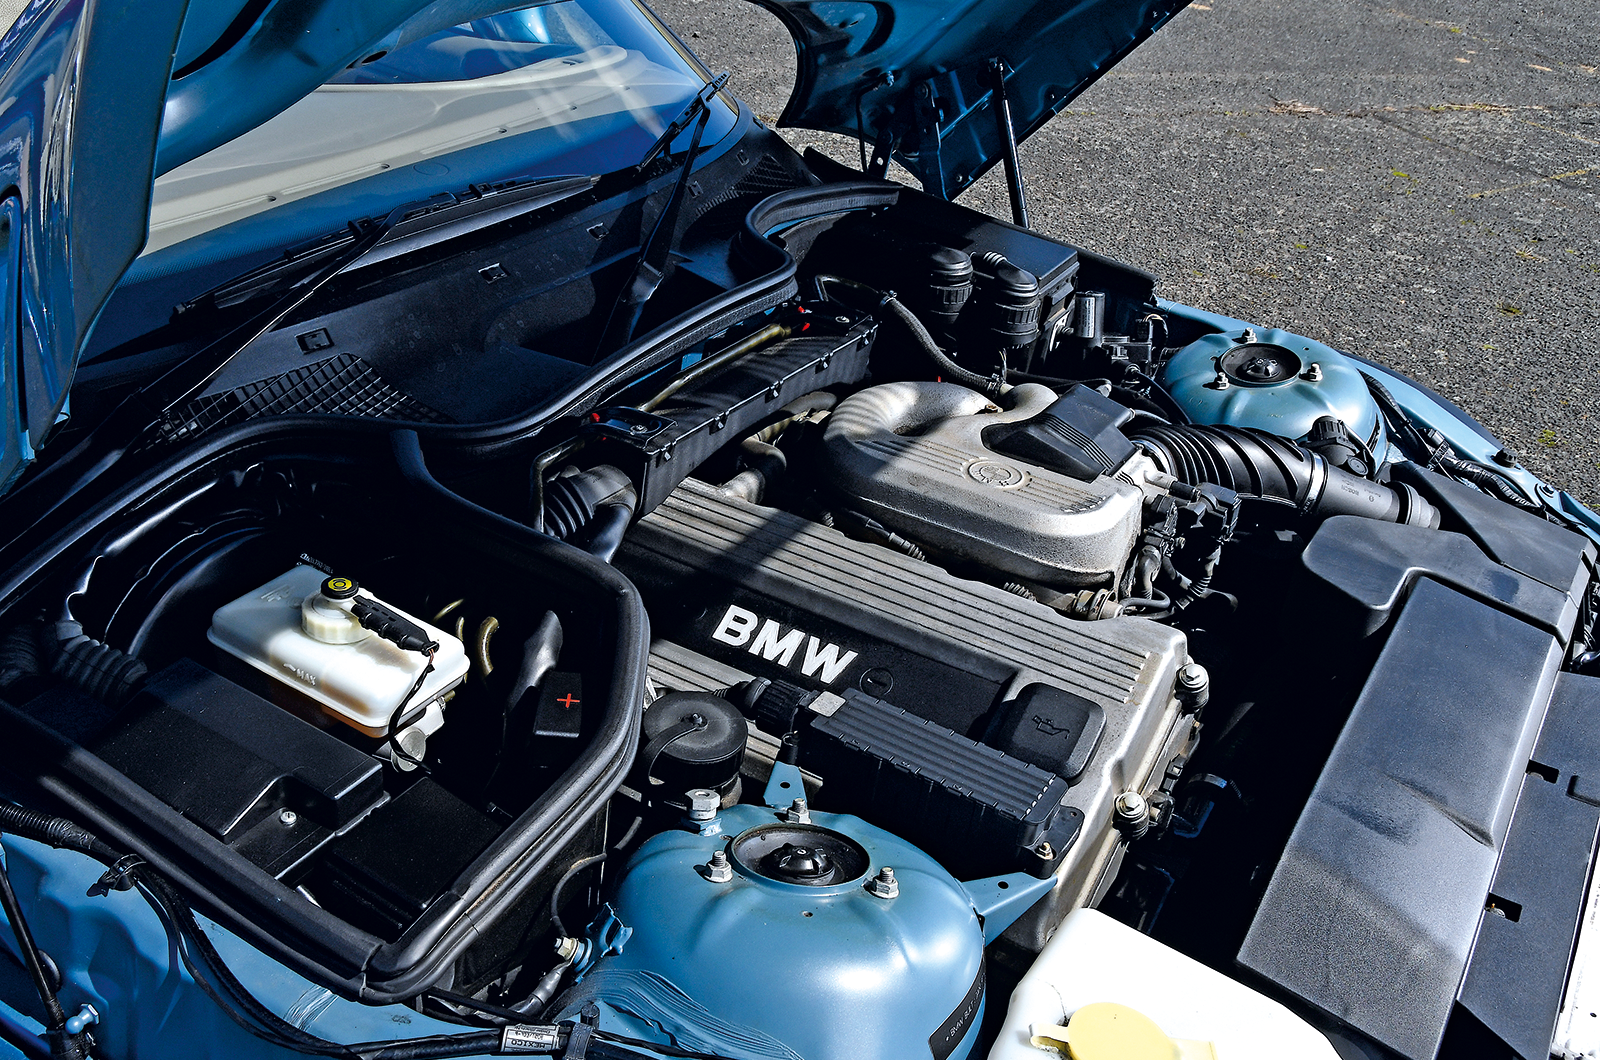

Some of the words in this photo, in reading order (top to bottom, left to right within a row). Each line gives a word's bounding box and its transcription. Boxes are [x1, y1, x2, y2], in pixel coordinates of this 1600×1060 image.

[712, 604, 859, 685] BMW
[296, 667, 316, 686] MAX
[511, 1039, 546, 1049] MEXICO
